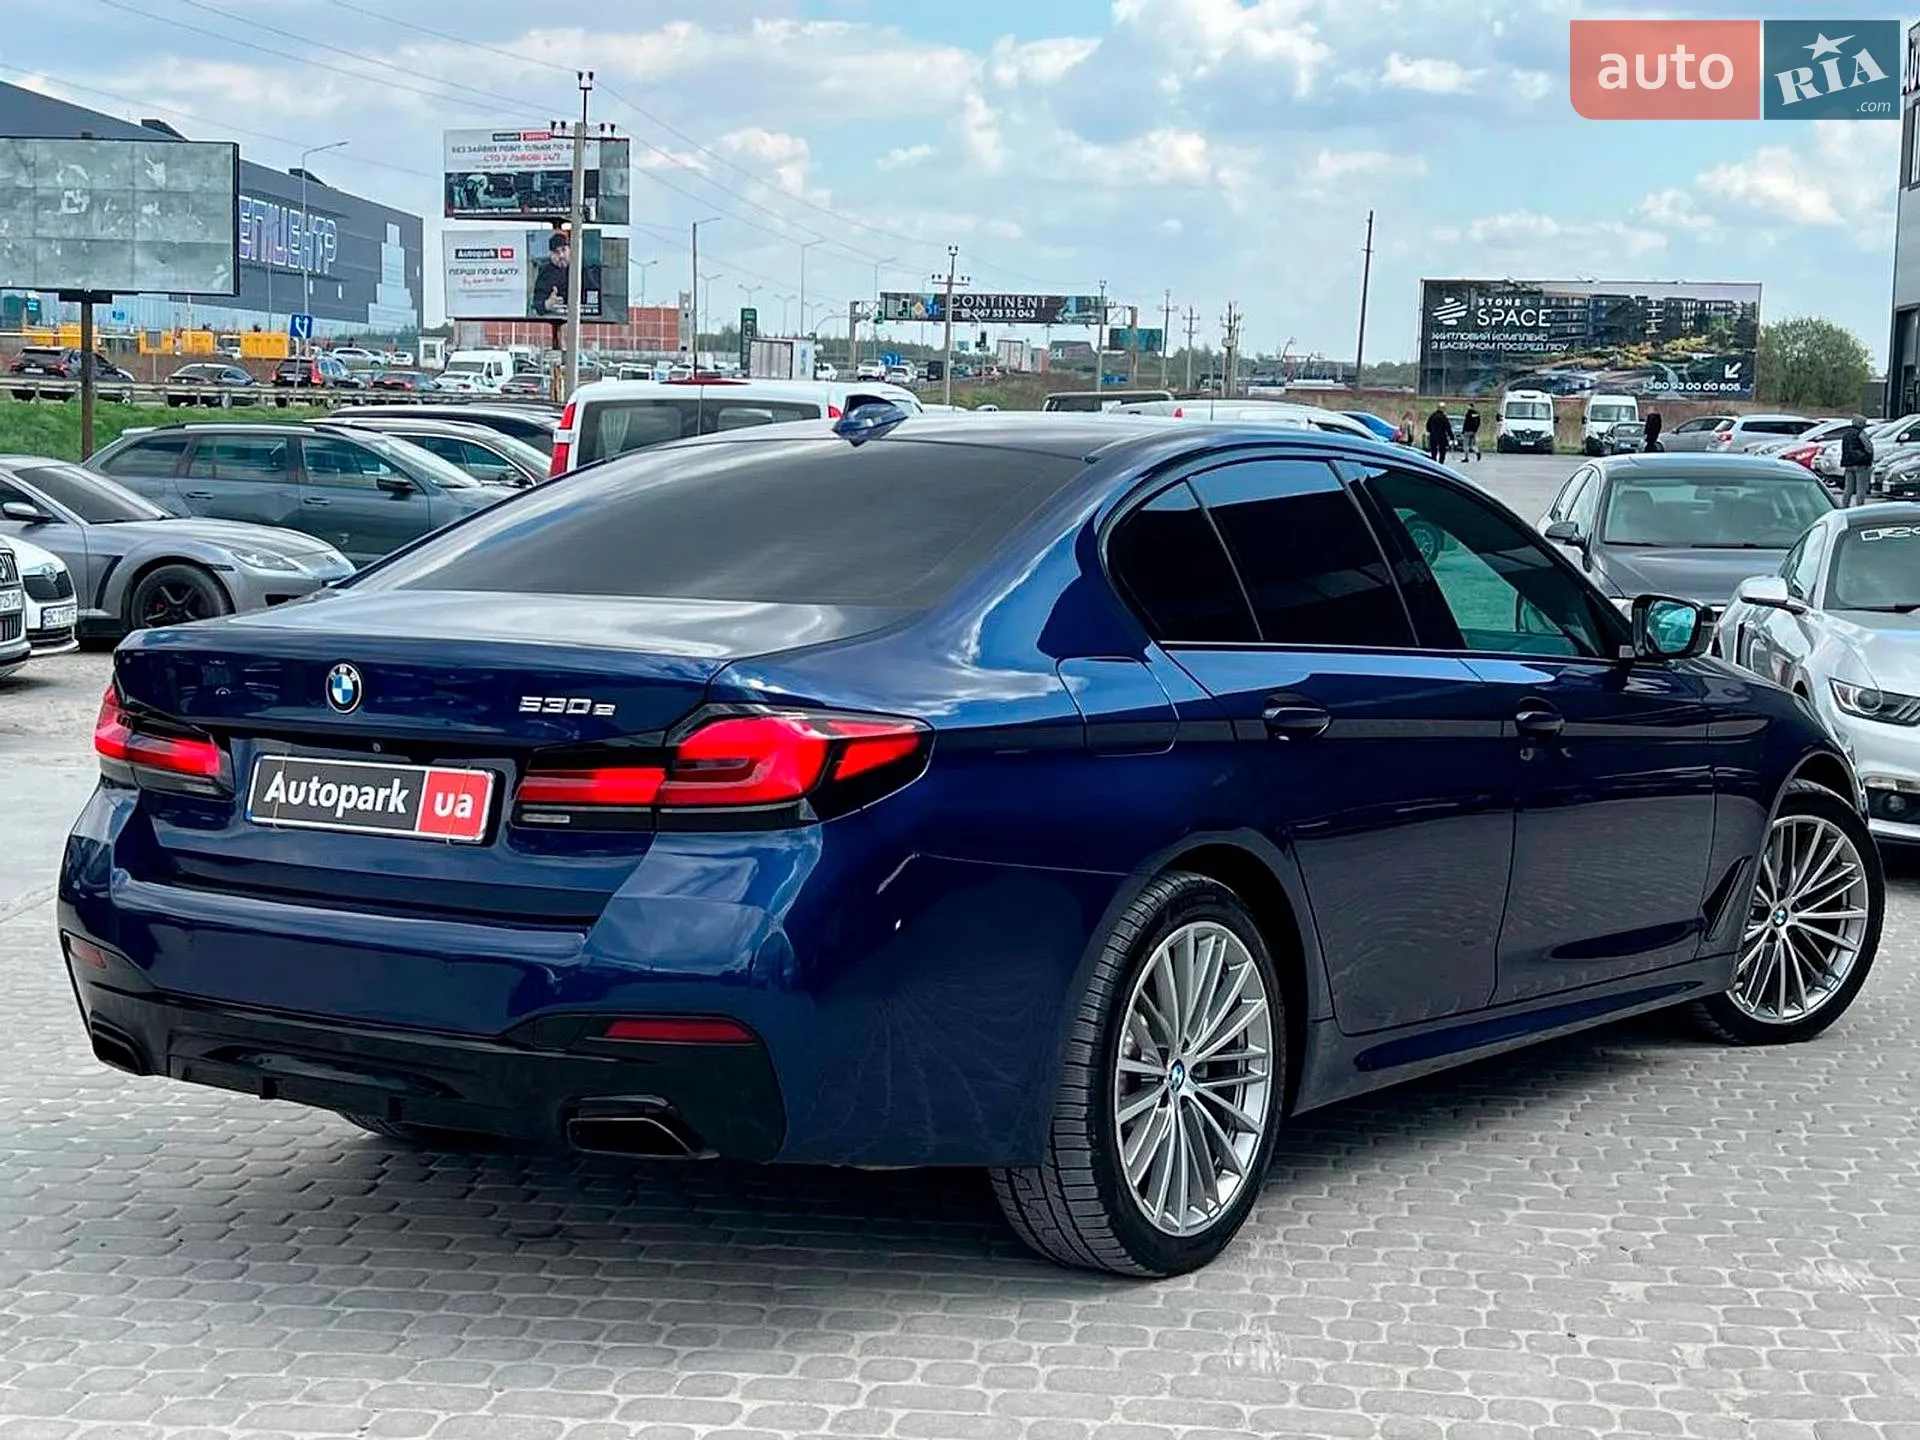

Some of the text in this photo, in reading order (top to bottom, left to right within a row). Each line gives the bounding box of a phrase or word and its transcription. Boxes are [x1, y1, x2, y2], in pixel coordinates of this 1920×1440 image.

[483, 153, 500, 163] СТО
[510, 151, 541, 162] ЛЬВОВІ
[457, 248, 496, 260] Autopark
[449, 267, 519, 276] ПЕРШІ ПО ФАКТУ
[951, 295, 1048, 308] CONTINENT
[1477, 298, 1522, 307] STONE
[1476, 308, 1553, 327] SPACE
[1431, 332, 1549, 342] ЖИТЛОВИЙ КОМПЛЕКС
[1439, 341, 1496, 350] БАСЕЙНОМ
[1685, 382, 1702, 391] 00
[1702, 382, 1719, 392] 00
[263, 770, 473, 819] Autopark ua
